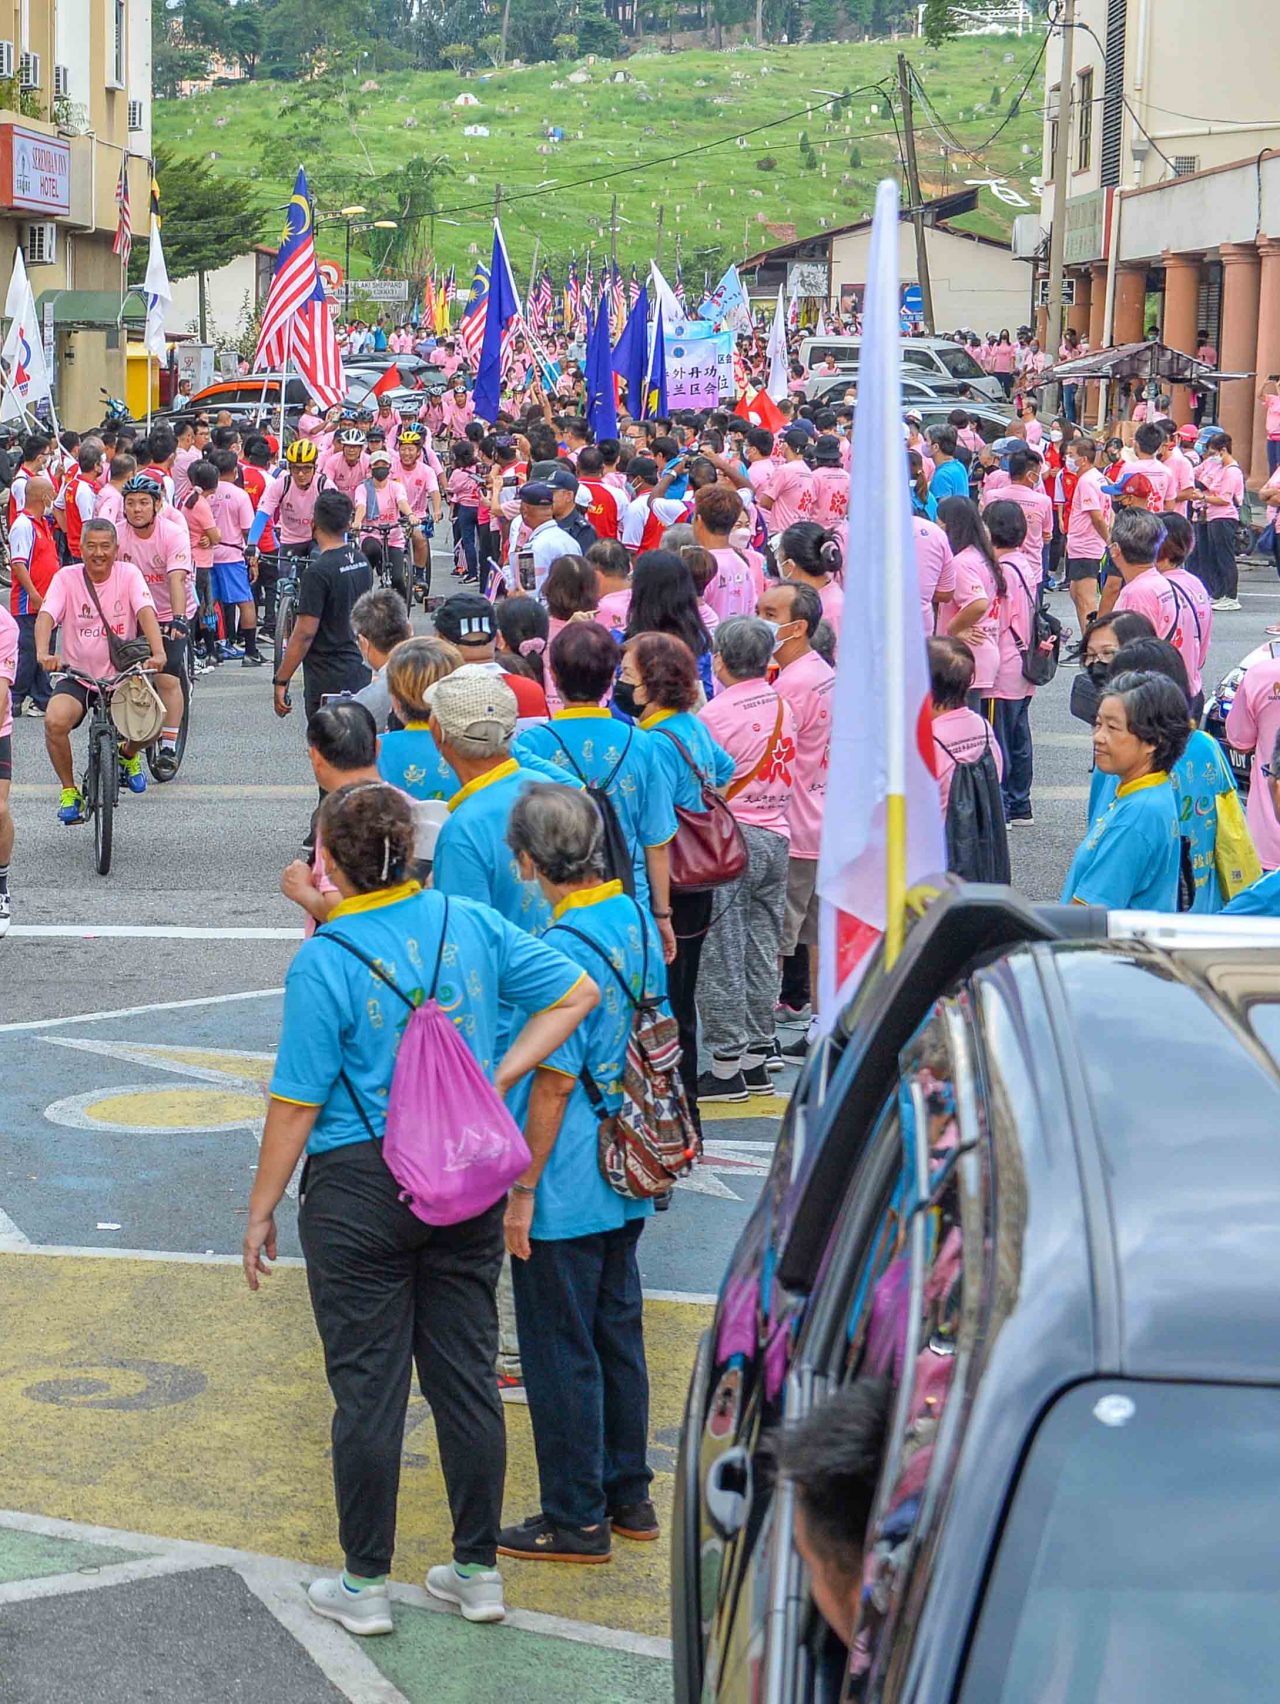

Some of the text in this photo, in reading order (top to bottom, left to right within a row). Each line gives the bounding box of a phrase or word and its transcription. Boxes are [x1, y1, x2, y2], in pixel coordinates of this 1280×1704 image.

[40, 176, 59, 198] HOTEL
[666, 365, 717, 380] 外丹功
[666, 382, 717, 397] 兰区会
